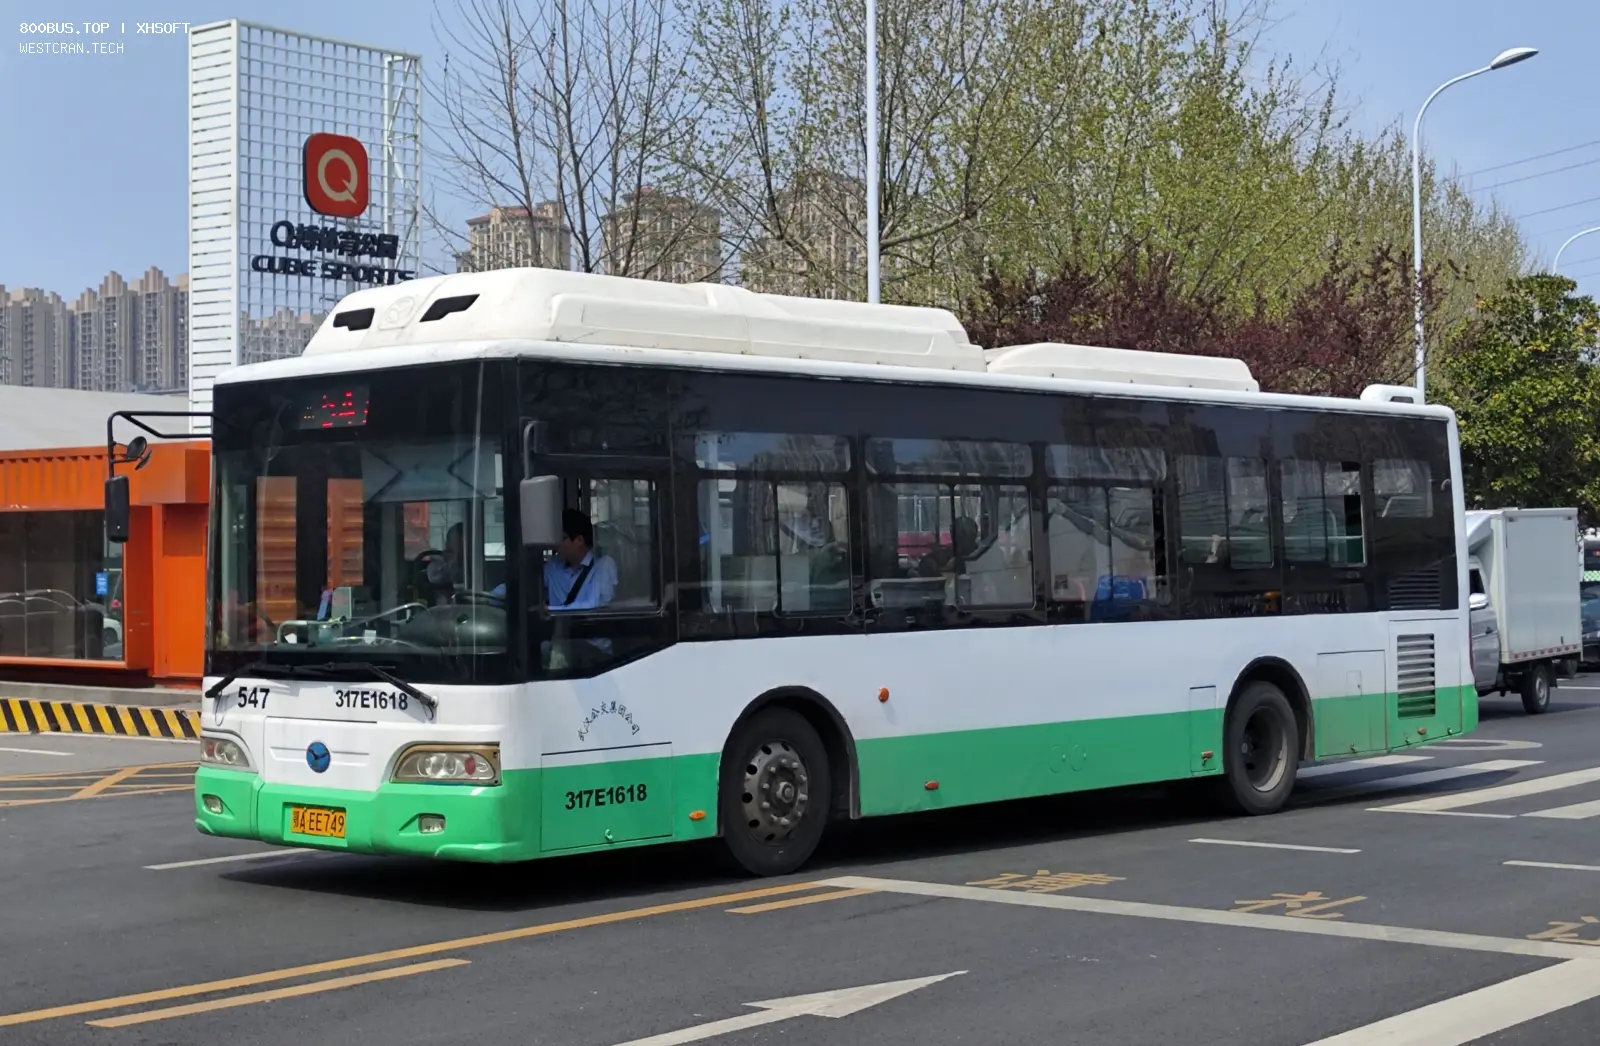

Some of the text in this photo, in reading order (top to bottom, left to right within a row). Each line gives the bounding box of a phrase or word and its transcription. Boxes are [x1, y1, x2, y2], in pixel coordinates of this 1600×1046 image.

[317, 148, 358, 204] Q
[251, 254, 317, 277] CUBE
[237, 686, 270, 709] 547
[335, 689, 408, 710] 317E1618
[565, 783, 648, 810] 317E1618
